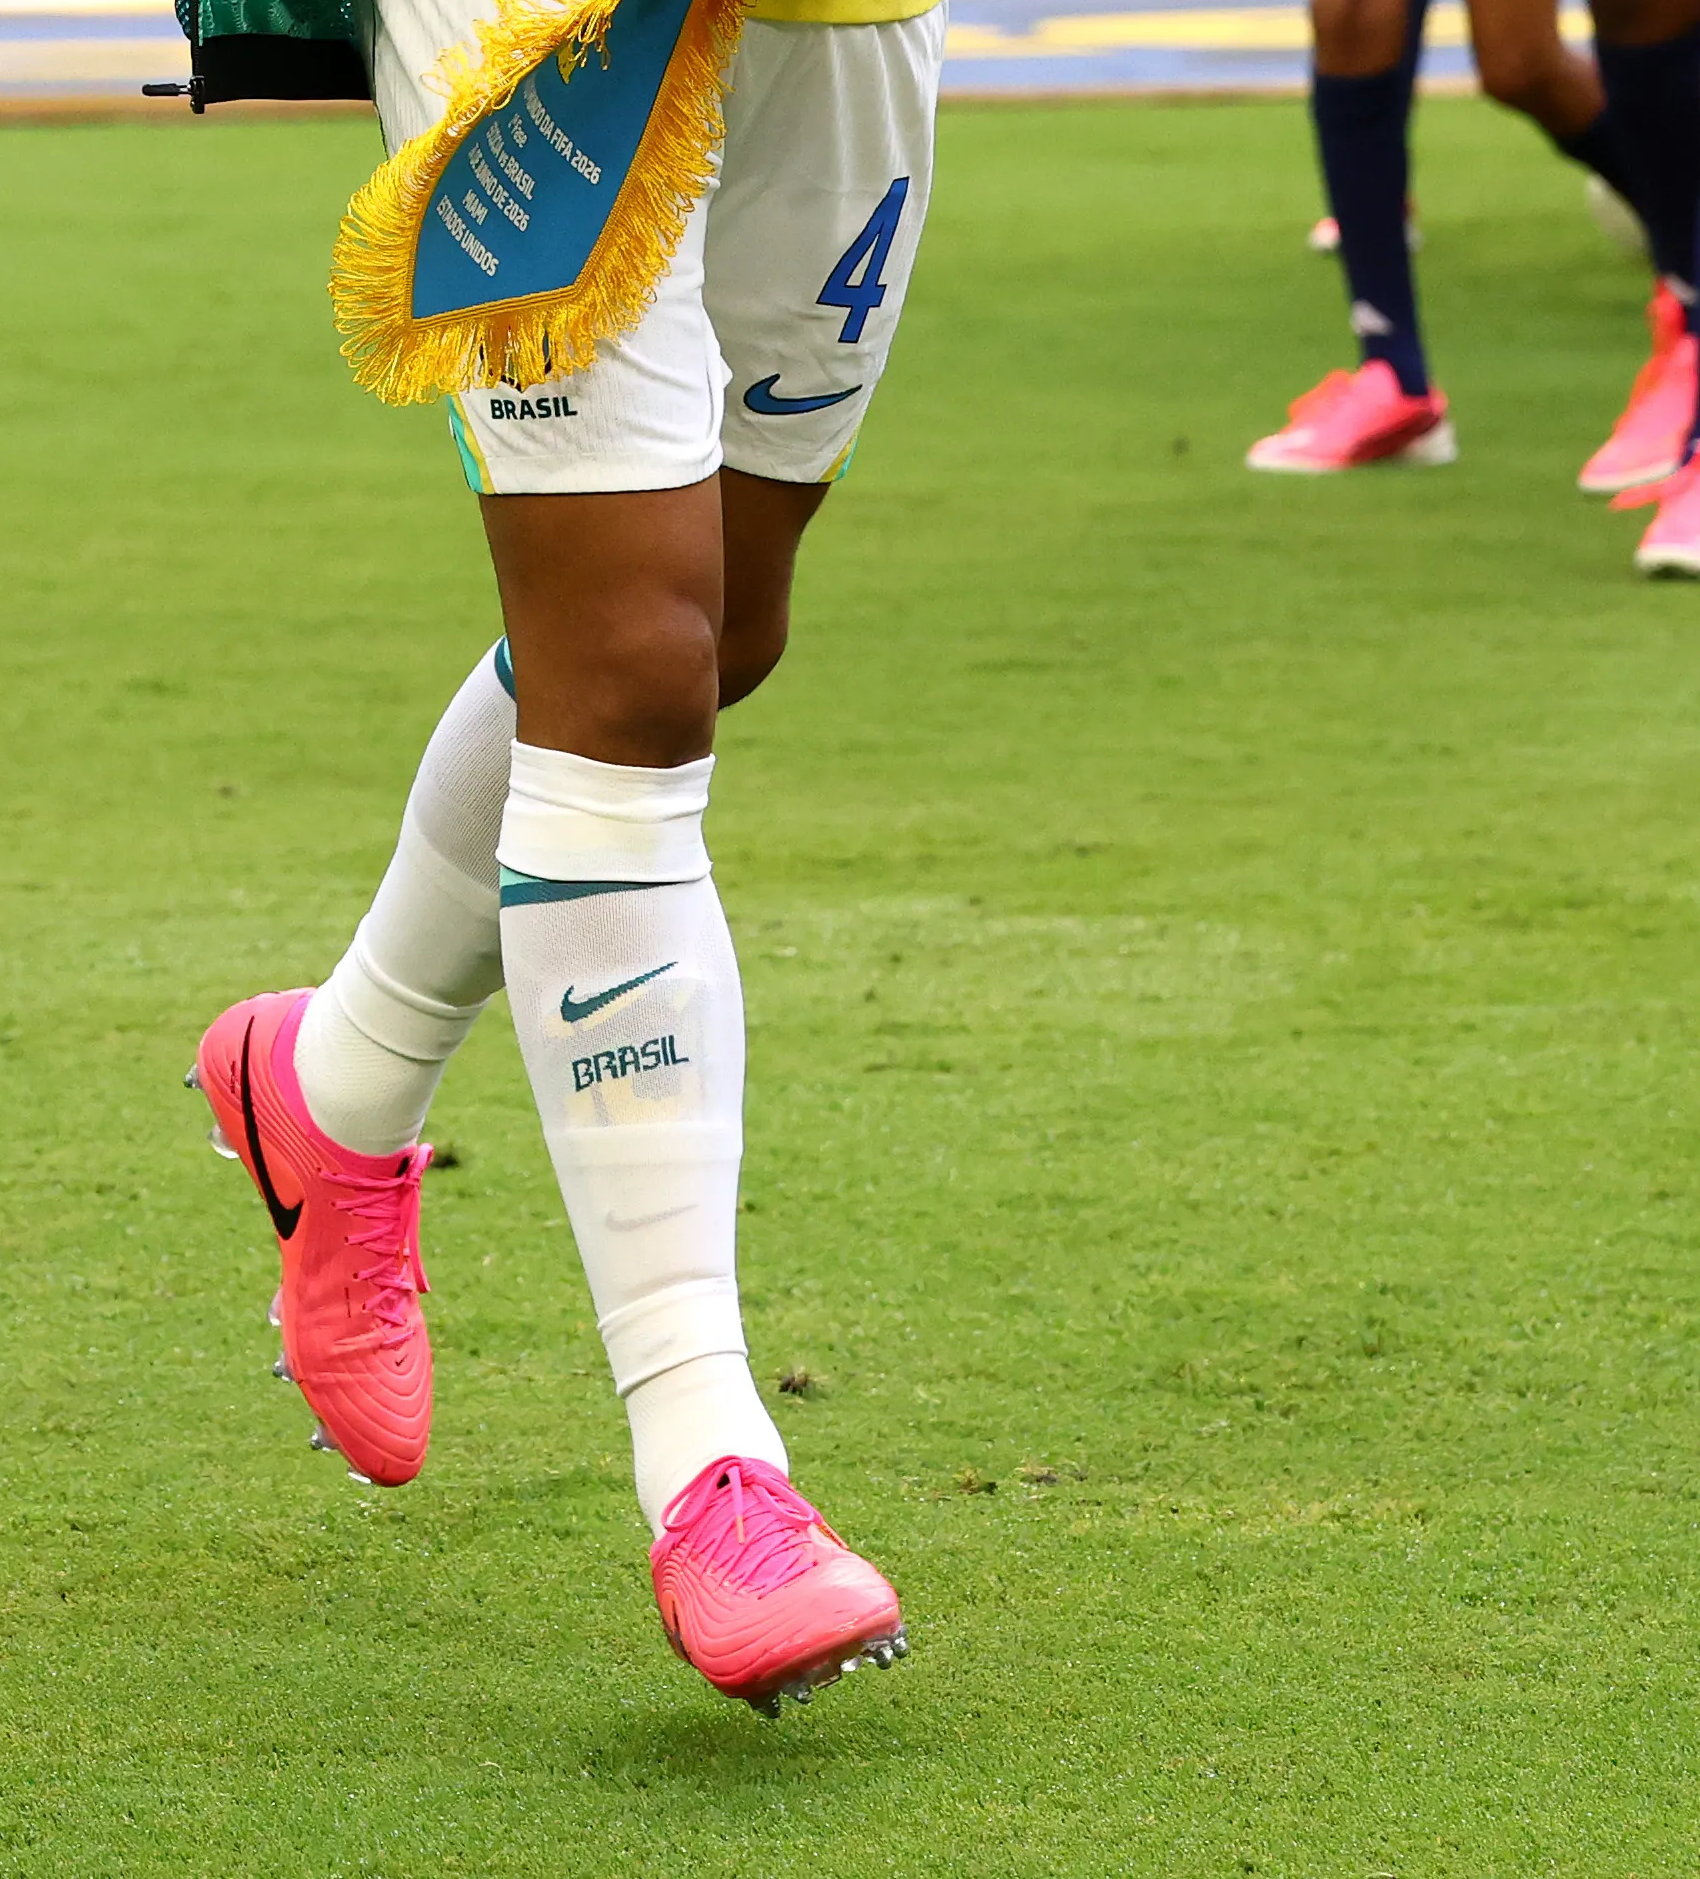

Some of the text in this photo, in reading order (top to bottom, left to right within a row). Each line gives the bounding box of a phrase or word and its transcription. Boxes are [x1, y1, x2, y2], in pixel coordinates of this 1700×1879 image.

[499, 150, 509, 168] vs
[504, 156, 535, 200] BRASIL
[539, 114, 555, 144] DA
[550, 128, 574, 162] FIFA
[570, 149, 602, 185] 2026
[462, 189, 489, 226] MIAMI
[492, 184, 509, 209] DE
[503, 198, 530, 232] 2026
[436, 194, 499, 277] ESTADOS UNIDOS
[815, 176, 910, 344] 4
[490, 396, 578, 420] BRASIL
[572, 1034, 689, 1092] BRASIL
